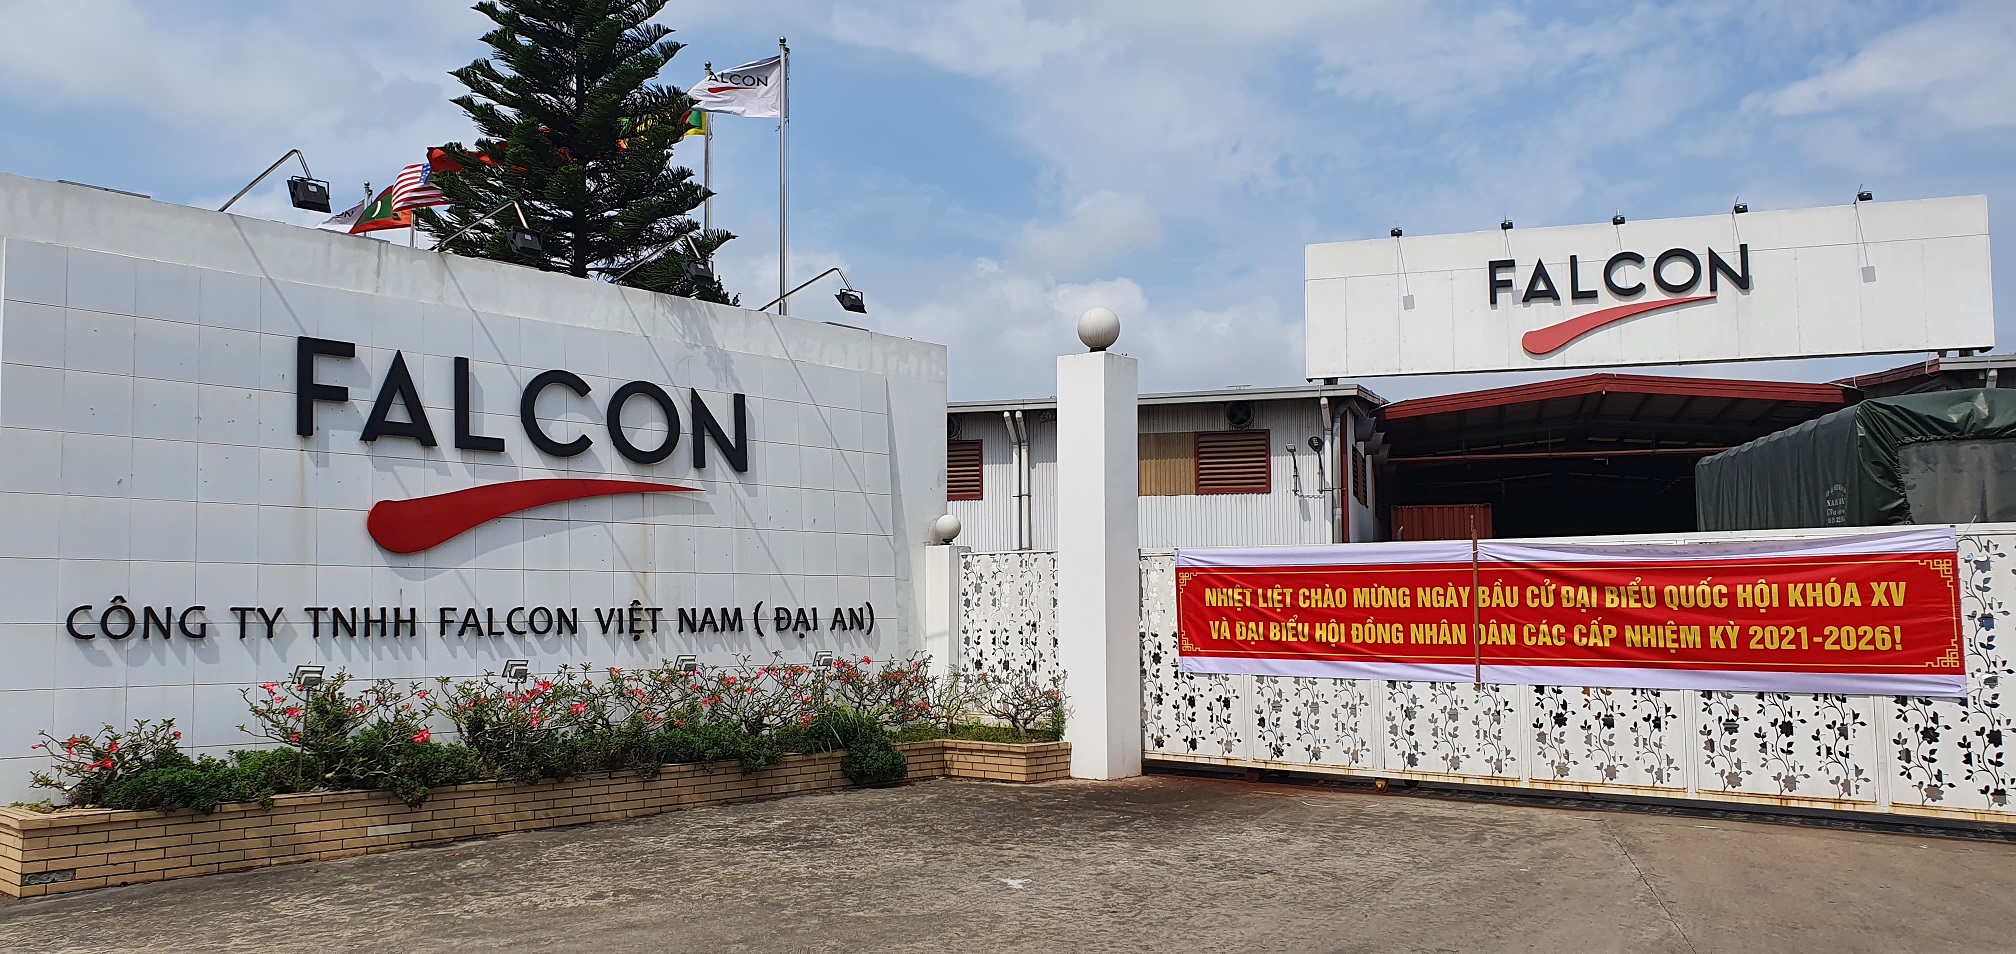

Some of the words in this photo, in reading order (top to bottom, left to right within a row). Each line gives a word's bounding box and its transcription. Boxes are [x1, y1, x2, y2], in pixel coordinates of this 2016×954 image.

[708, 71, 768, 87] ALCON
[1488, 243, 1750, 305] FALCON
[296, 336, 749, 475] FALCON
[1204, 584, 1253, 611] NHIỆT
[1257, 584, 1292, 611] LIỆT
[1298, 583, 1347, 608] CHÀO
[1353, 582, 1411, 608] MỪNG
[1416, 581, 1471, 608] NGÀY
[1477, 578, 1519, 608] BẦU
[1525, 578, 1557, 608] CỬ
[1560, 585, 1598, 613] ĐẠI
[1604, 577, 1656, 609] BIỂU
[1663, 577, 1728, 611] QUỐC
[1736, 578, 1779, 613] HỘI
[1787, 577, 1862, 607] KHÓA
[1869, 581, 1907, 607] XV
[65, 594, 208, 641] CÔNG
[230, 606, 284, 640] TY
[304, 606, 417, 639] TNHH
[439, 606, 578, 638] FALCON
[595, 599, 665, 642] VIỆT
[678, 606, 744, 635] NAM
[829, 601, 875, 637] AN)
[1208, 617, 1231, 640] VÀ
[1234, 620, 1264, 645] ĐẠI
[1269, 614, 1310, 642] BIỂU
[1314, 618, 1346, 647] HỘI
[1351, 616, 1404, 644] ĐỒNG
[1410, 619, 1467, 645] NHÂN
[1473, 619, 1517, 646] DÂN
[1522, 619, 1566, 646] CÁC
[1572, 616, 1618, 648] CẤP
[1624, 620, 1702, 654] NHIỆM
[1708, 620, 1740, 649] KỲ
